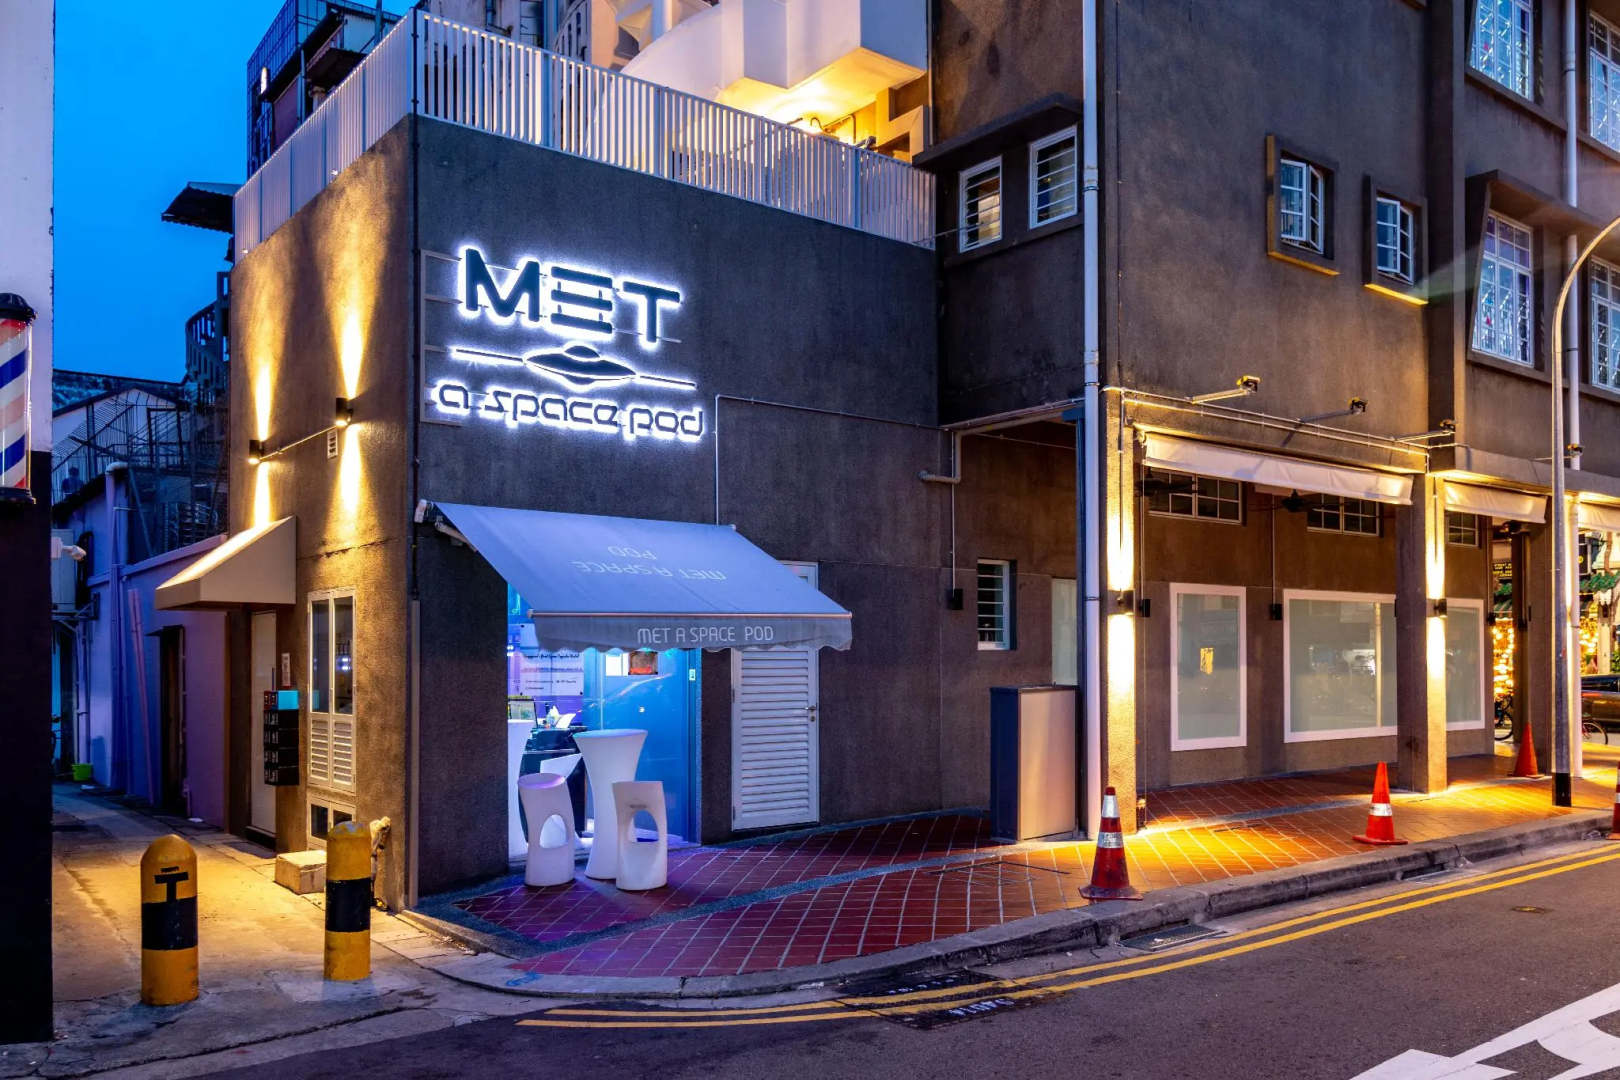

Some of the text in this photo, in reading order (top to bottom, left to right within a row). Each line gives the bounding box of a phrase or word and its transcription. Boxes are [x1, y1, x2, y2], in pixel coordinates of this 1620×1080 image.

[466, 248, 681, 344] MET
[438, 384, 704, 437] a space pod
[607, 546, 658, 560] POD
[572, 561, 728, 580] MET A SPACE
[637, 626, 774, 644] MET A SPACE POD
